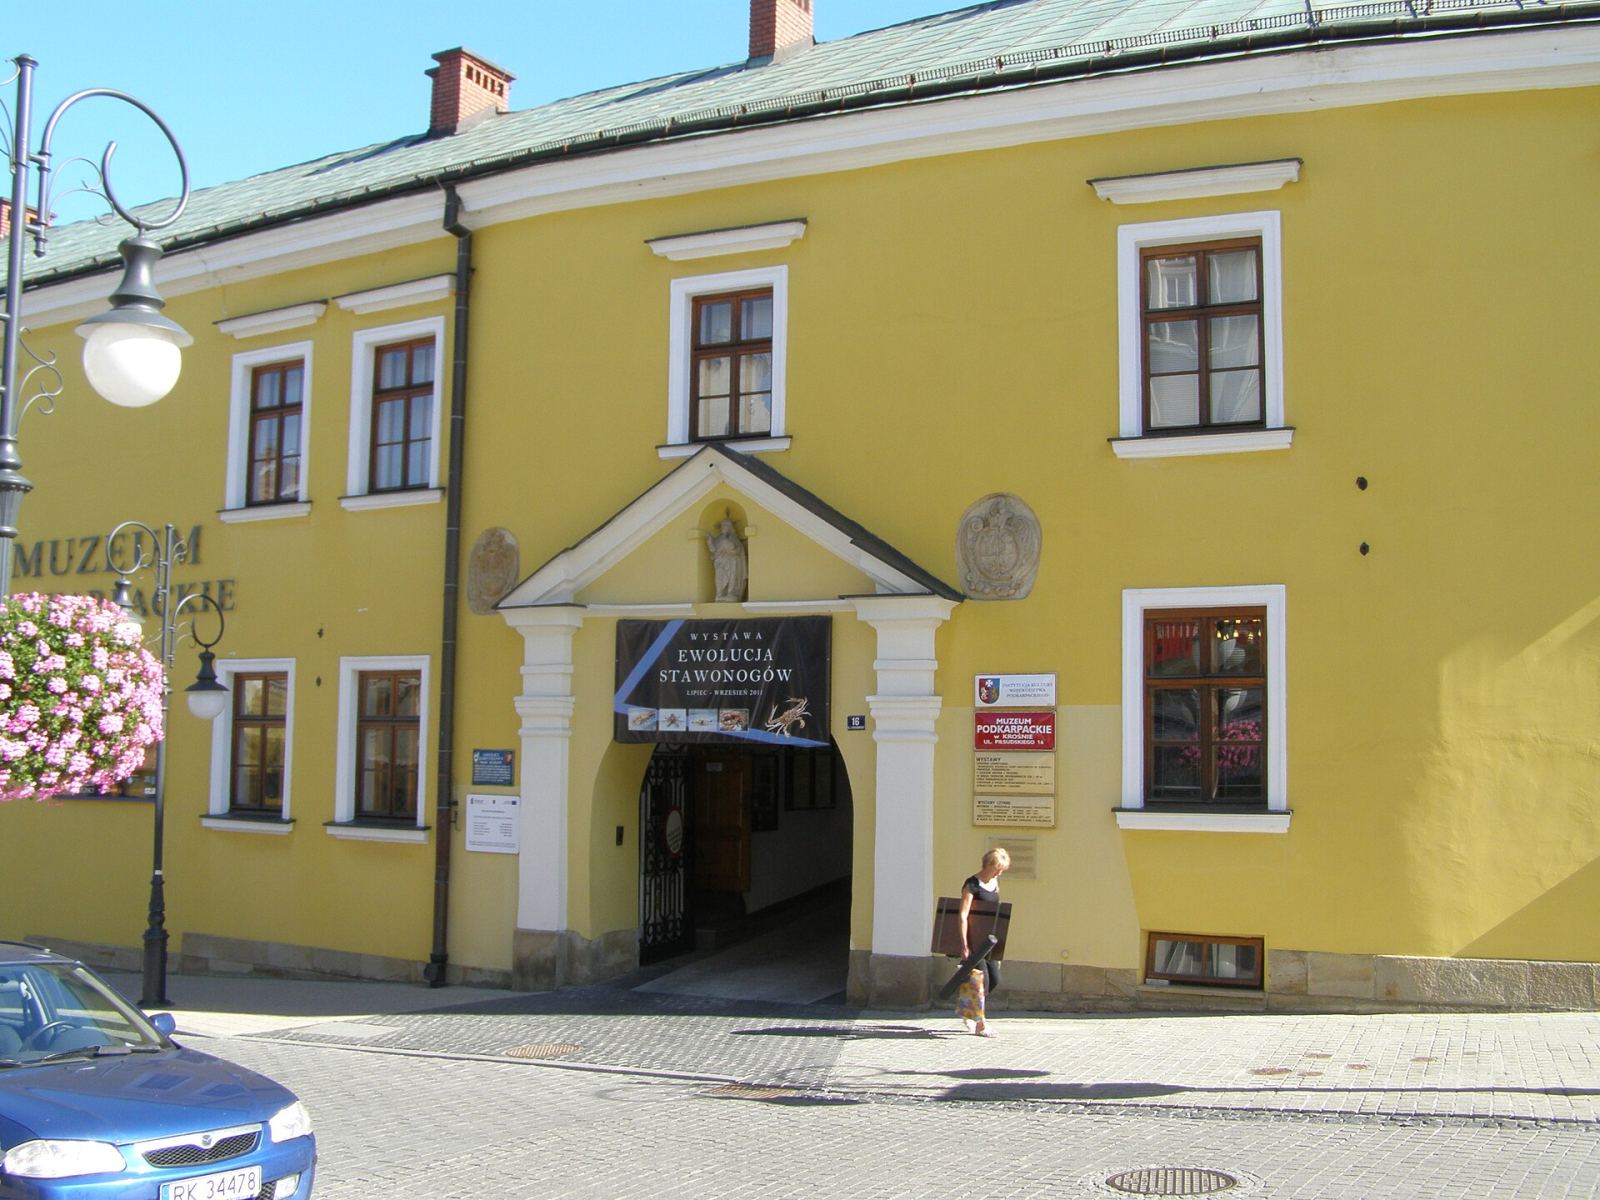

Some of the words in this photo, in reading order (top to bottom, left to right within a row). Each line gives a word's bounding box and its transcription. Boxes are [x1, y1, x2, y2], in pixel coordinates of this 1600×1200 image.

[689, 631, 763, 641] WYSTAWA
[678, 648, 774, 662] EWOLUCJA
[659, 665, 792, 682] STAWONOGÓW
[851, 717, 860, 726] 16
[976, 725, 1052, 734] PODKARPACKIE
[1002, 732, 1034, 740] KROŚNIE
[173, 1183, 198, 1200] RK
[206, 1171, 256, 1199] 34478
